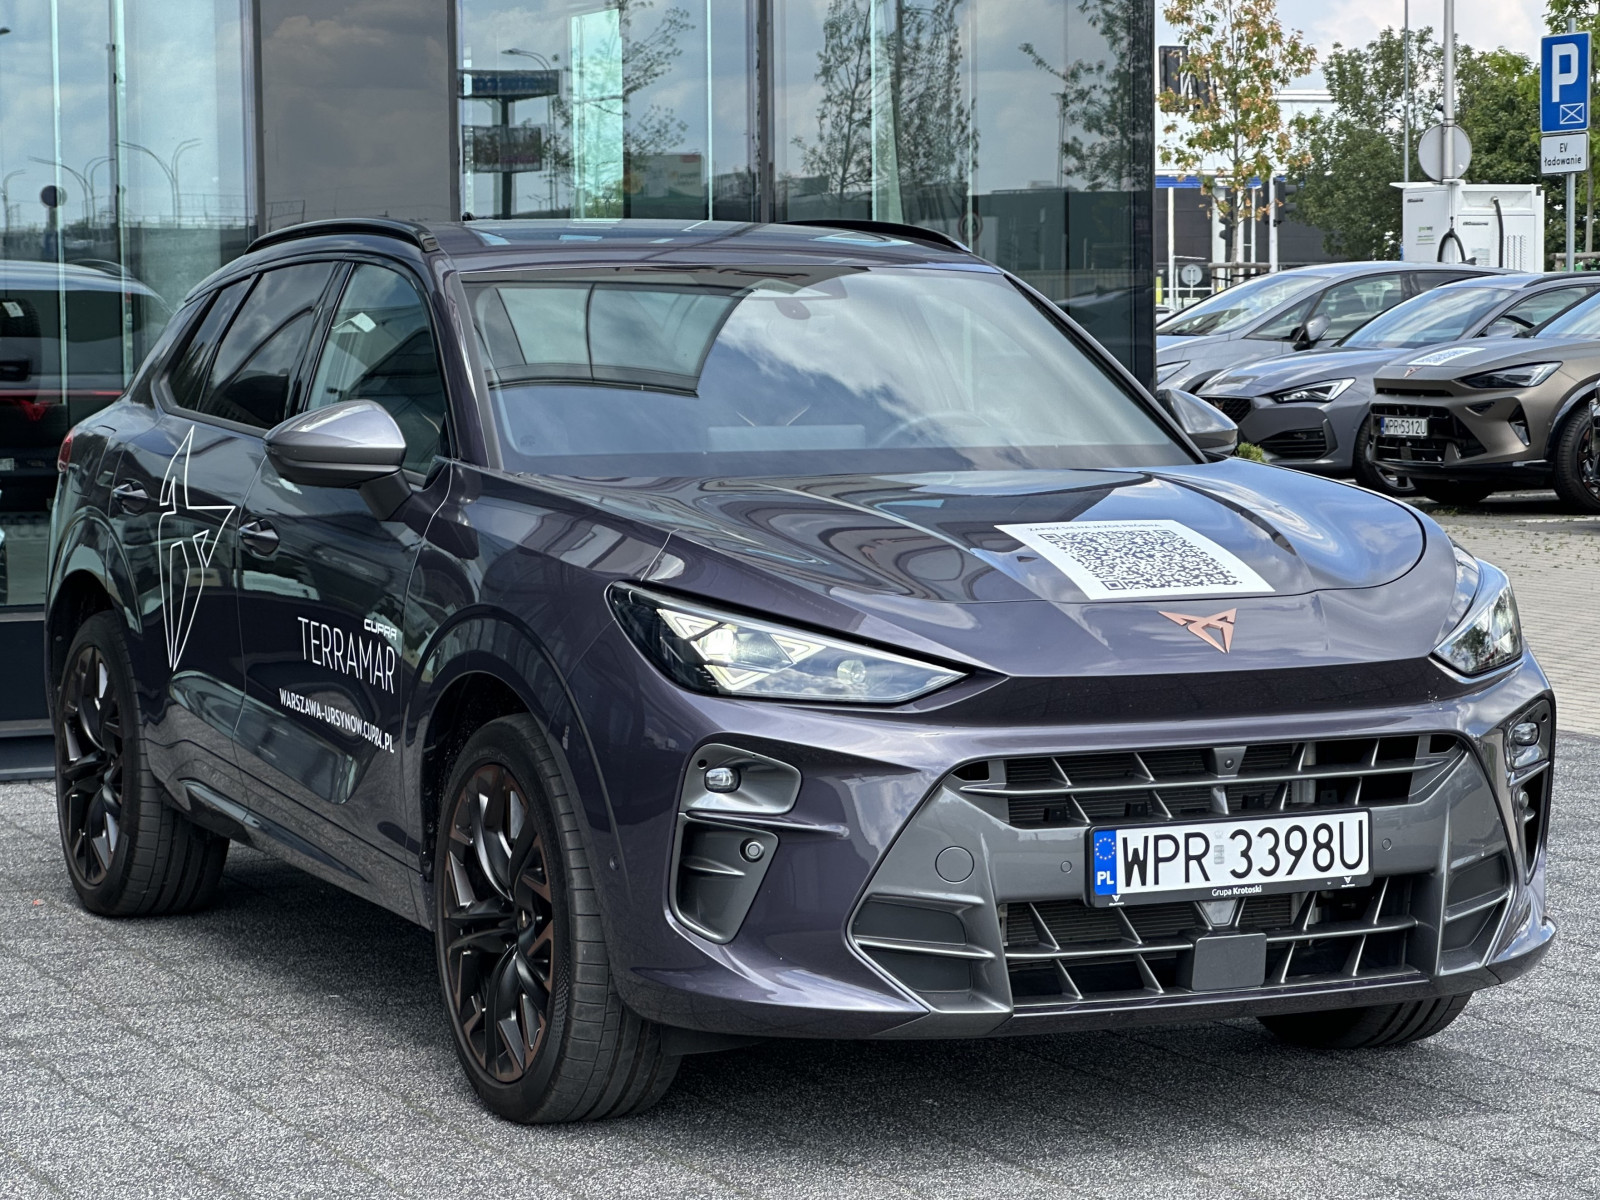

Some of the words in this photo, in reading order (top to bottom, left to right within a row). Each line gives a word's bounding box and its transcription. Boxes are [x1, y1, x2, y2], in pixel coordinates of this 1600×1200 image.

[1552, 43, 1579, 103] P
[1559, 142, 1568, 153] EV
[1543, 156, 1582, 167] ładowanie
[1385, 419, 1399, 433] WPR
[1401, 420, 1426, 435] 5312U
[364, 618, 397, 641] CUPRA
[297, 616, 396, 694] TERRAMAR
[1122, 832, 1211, 888] WPR
[1229, 819, 1364, 879] 3398U
[1096, 870, 1115, 886] PL
[1211, 887, 1232, 897] Grupa
[1232, 884, 1262, 895] Krotoski
